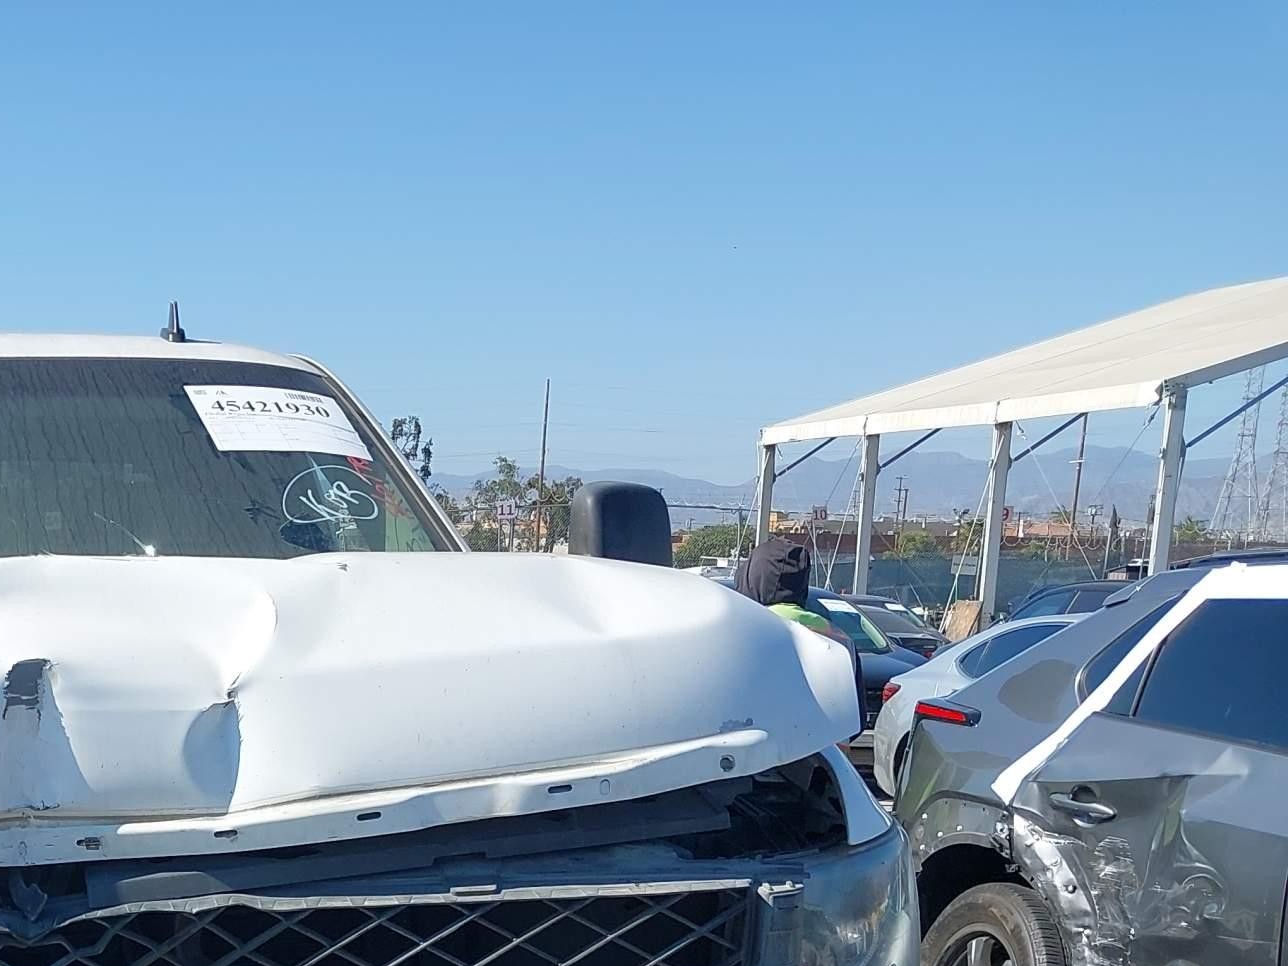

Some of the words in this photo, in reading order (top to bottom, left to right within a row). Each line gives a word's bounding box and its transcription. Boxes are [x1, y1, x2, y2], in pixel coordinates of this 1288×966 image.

[211, 400, 330, 418] 45421930
[498, 504, 514, 516] 11
[813, 509, 827, 520] 10
